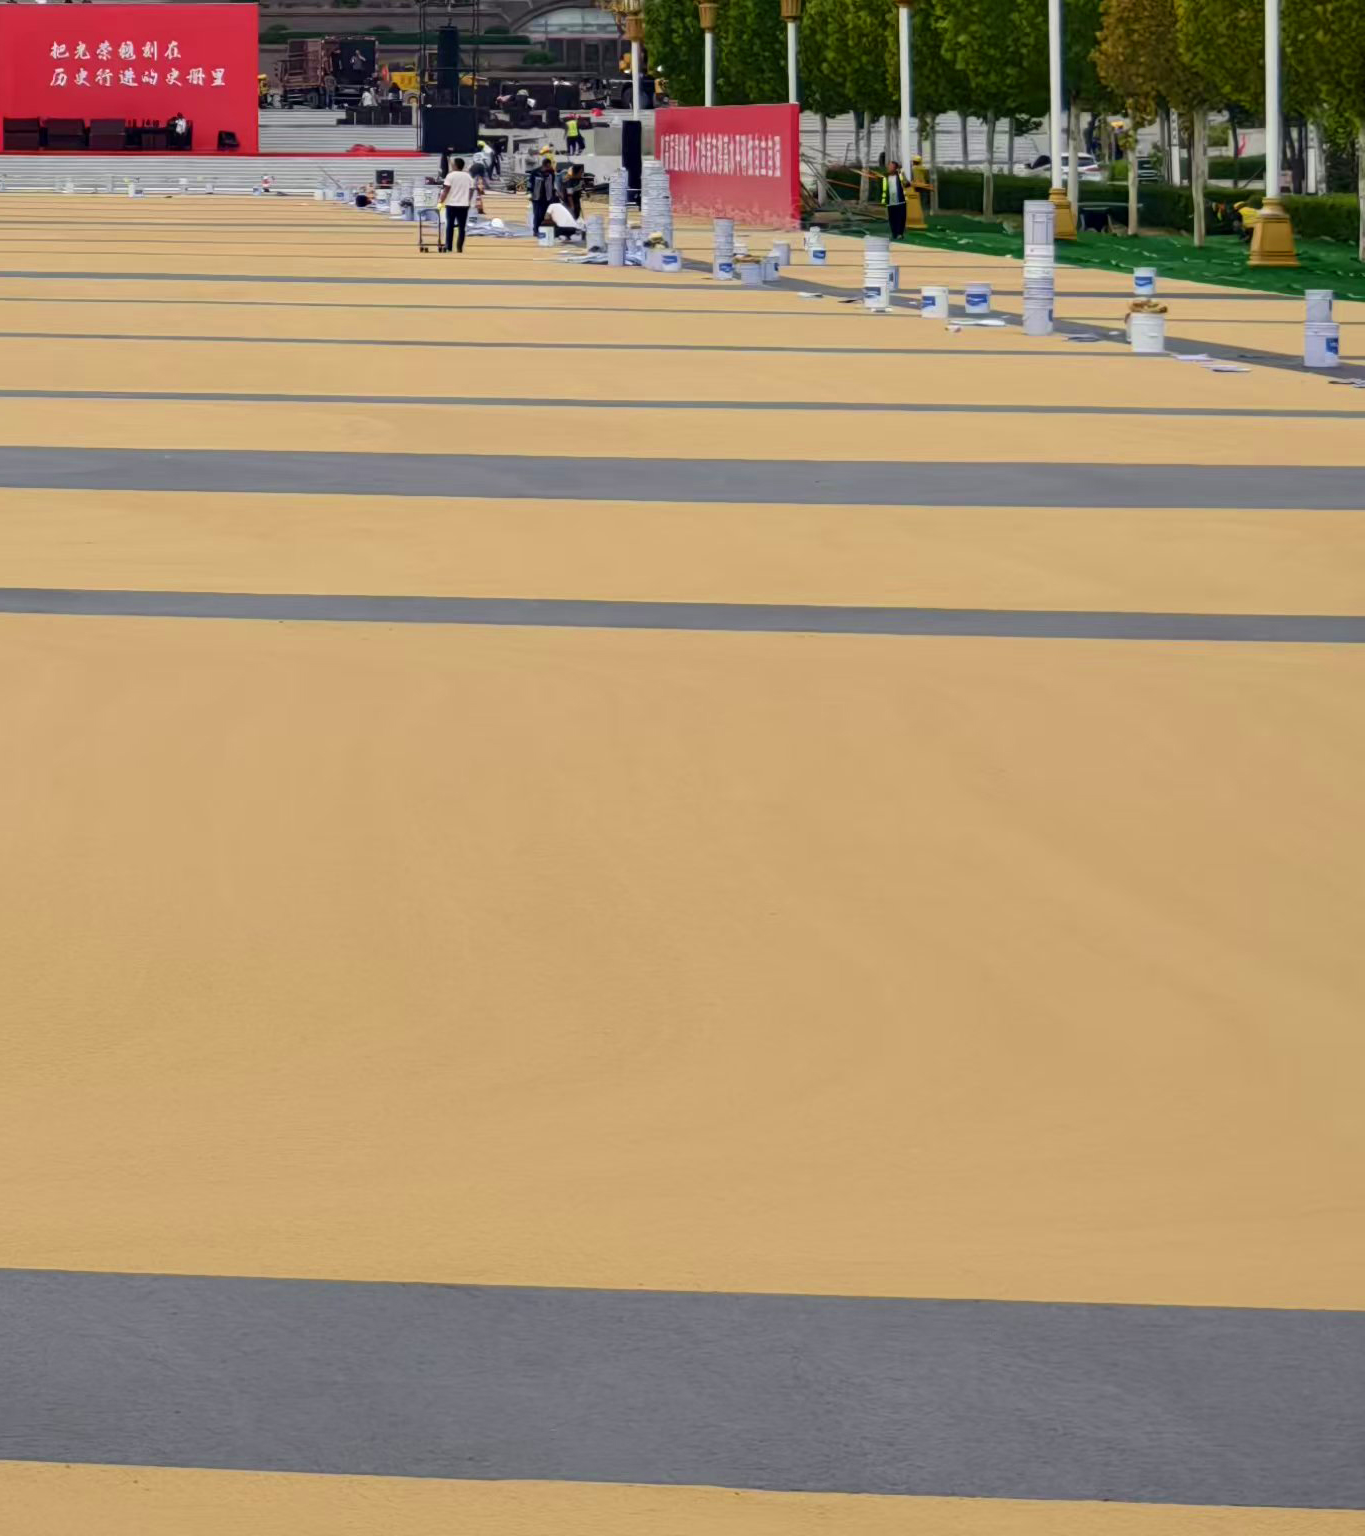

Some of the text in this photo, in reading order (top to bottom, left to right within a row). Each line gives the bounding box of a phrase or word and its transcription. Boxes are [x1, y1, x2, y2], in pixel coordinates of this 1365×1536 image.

[49, 66, 227, 87] 历史行进的史册里
